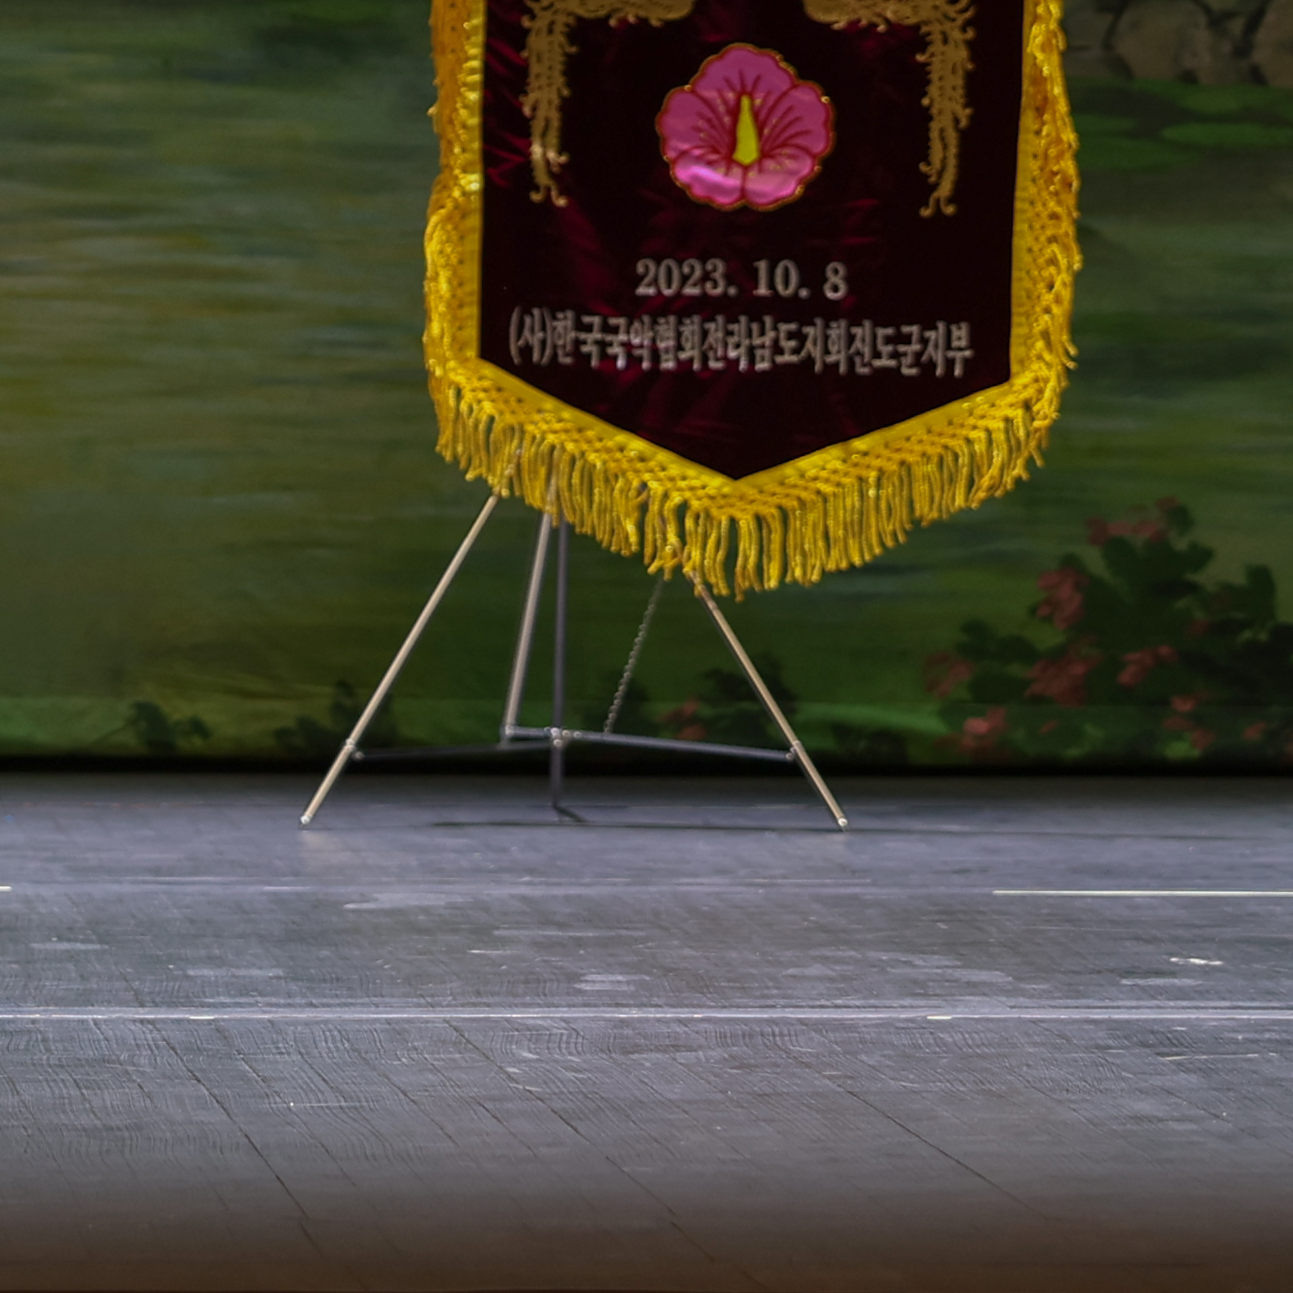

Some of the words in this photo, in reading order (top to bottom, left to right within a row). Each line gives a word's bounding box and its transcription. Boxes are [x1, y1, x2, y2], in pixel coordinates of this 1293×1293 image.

[634, 257, 740, 298] 2023.
[752, 258, 812, 300] 10.
[822, 260, 850, 301] 8
